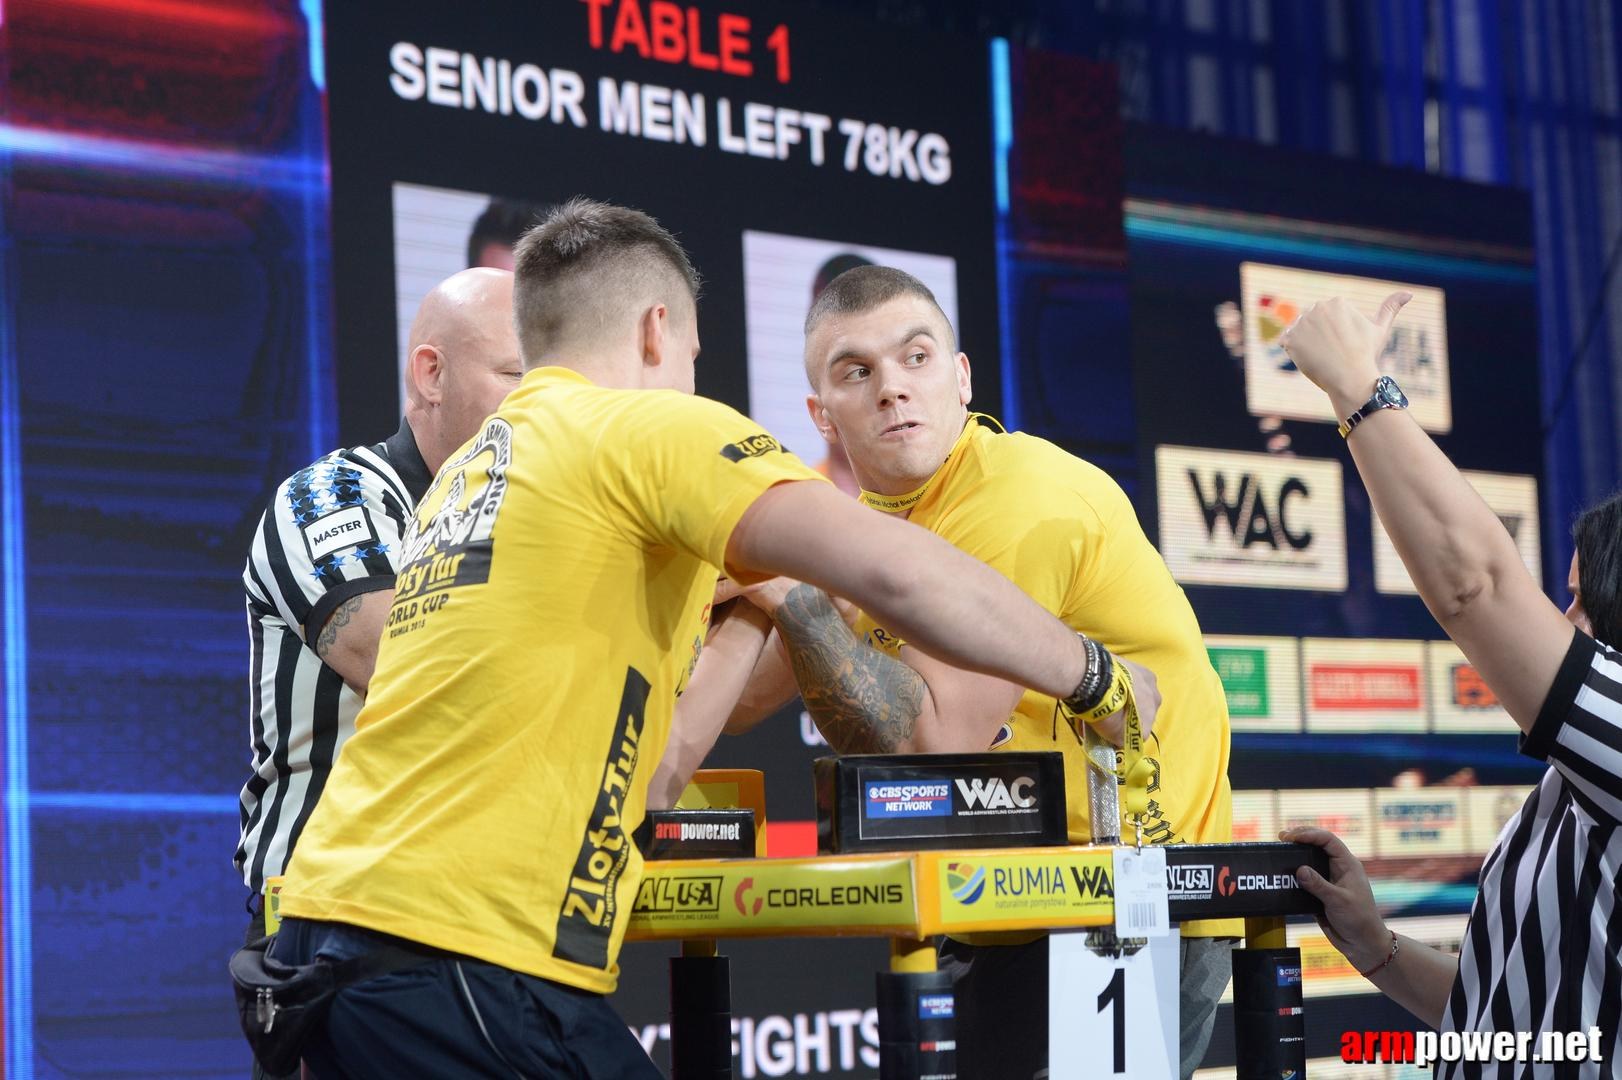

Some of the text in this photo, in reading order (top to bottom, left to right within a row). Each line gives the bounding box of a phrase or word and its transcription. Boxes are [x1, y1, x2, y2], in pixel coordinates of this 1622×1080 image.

[579, 0, 791, 84] TABLE 1
[389, 42, 952, 186] SENIOR MEN LEFT 78KG
[1186, 467, 1314, 552] WAC
[313, 520, 362, 546] MASTER
[385, 593, 449, 628] ORLD CUP
[885, 801, 933, 812] NETWORK
[954, 776, 1037, 810] WAC
[655, 821, 740, 841] armpower.net
[634, 877, 714, 913] AL USA
[767, 884, 903, 908] CORLEONIS
[994, 865, 1066, 897] RUMIA
[1070, 866, 1114, 898] WA
[1185, 868, 1211, 891] USA
[1237, 874, 1299, 891] CORLEON
[1096, 967, 1126, 1074] 1
[731, 1008, 880, 1079] IGHTS
